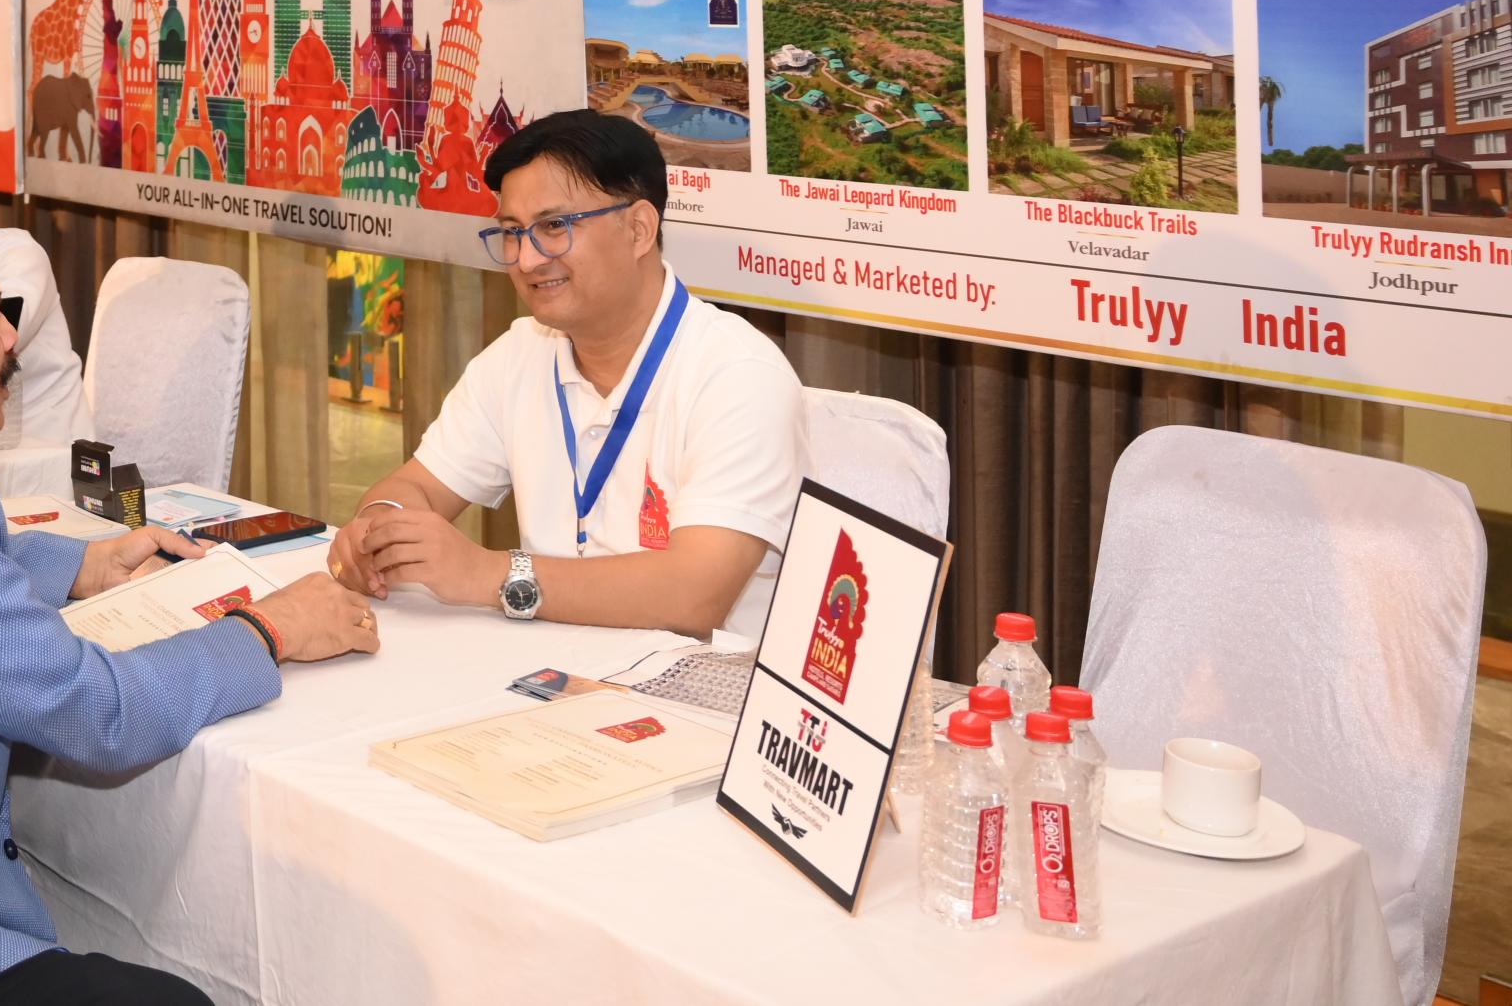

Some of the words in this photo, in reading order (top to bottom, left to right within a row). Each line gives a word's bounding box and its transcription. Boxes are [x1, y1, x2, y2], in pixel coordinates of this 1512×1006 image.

[682, 170, 711, 192] Bagh
[779, 179, 800, 198] The
[804, 182, 839, 202] Jawai
[844, 185, 894, 209] Leopard
[899, 190, 957, 215] Kingdom
[136, 183, 170, 204] YOUR
[173, 189, 250, 216] ALL-IN-ONE
[253, 199, 305, 226] TRAVEL
[309, 207, 393, 238] SOLUTION!
[668, 199, 704, 213] mbore
[1025, 201, 1052, 223] The
[1057, 204, 1144, 232] Blackbuck
[1149, 212, 1197, 236] Trails
[845, 217, 883, 233] Jawai
[1067, 240, 1150, 262] Velavadar
[1311, 226, 1373, 258] Trulyy
[1380, 232, 1481, 263] Rudransh
[1490, 241, 1512, 265] In
[737, 245, 826, 286] Managed
[832, 258, 849, 286] &
[854, 261, 958, 302] Marketed
[965, 274, 998, 313] by:
[1070, 278, 1189, 347] Trulyy
[1241, 298, 1348, 358] India
[1368, 271, 1459, 296] Jodhpur
[810, 636, 848, 679] INDIA
[757, 719, 854, 816] TRAVMART
[983, 813, 998, 854] DROPS
[1043, 809, 1061, 853] DROPS
